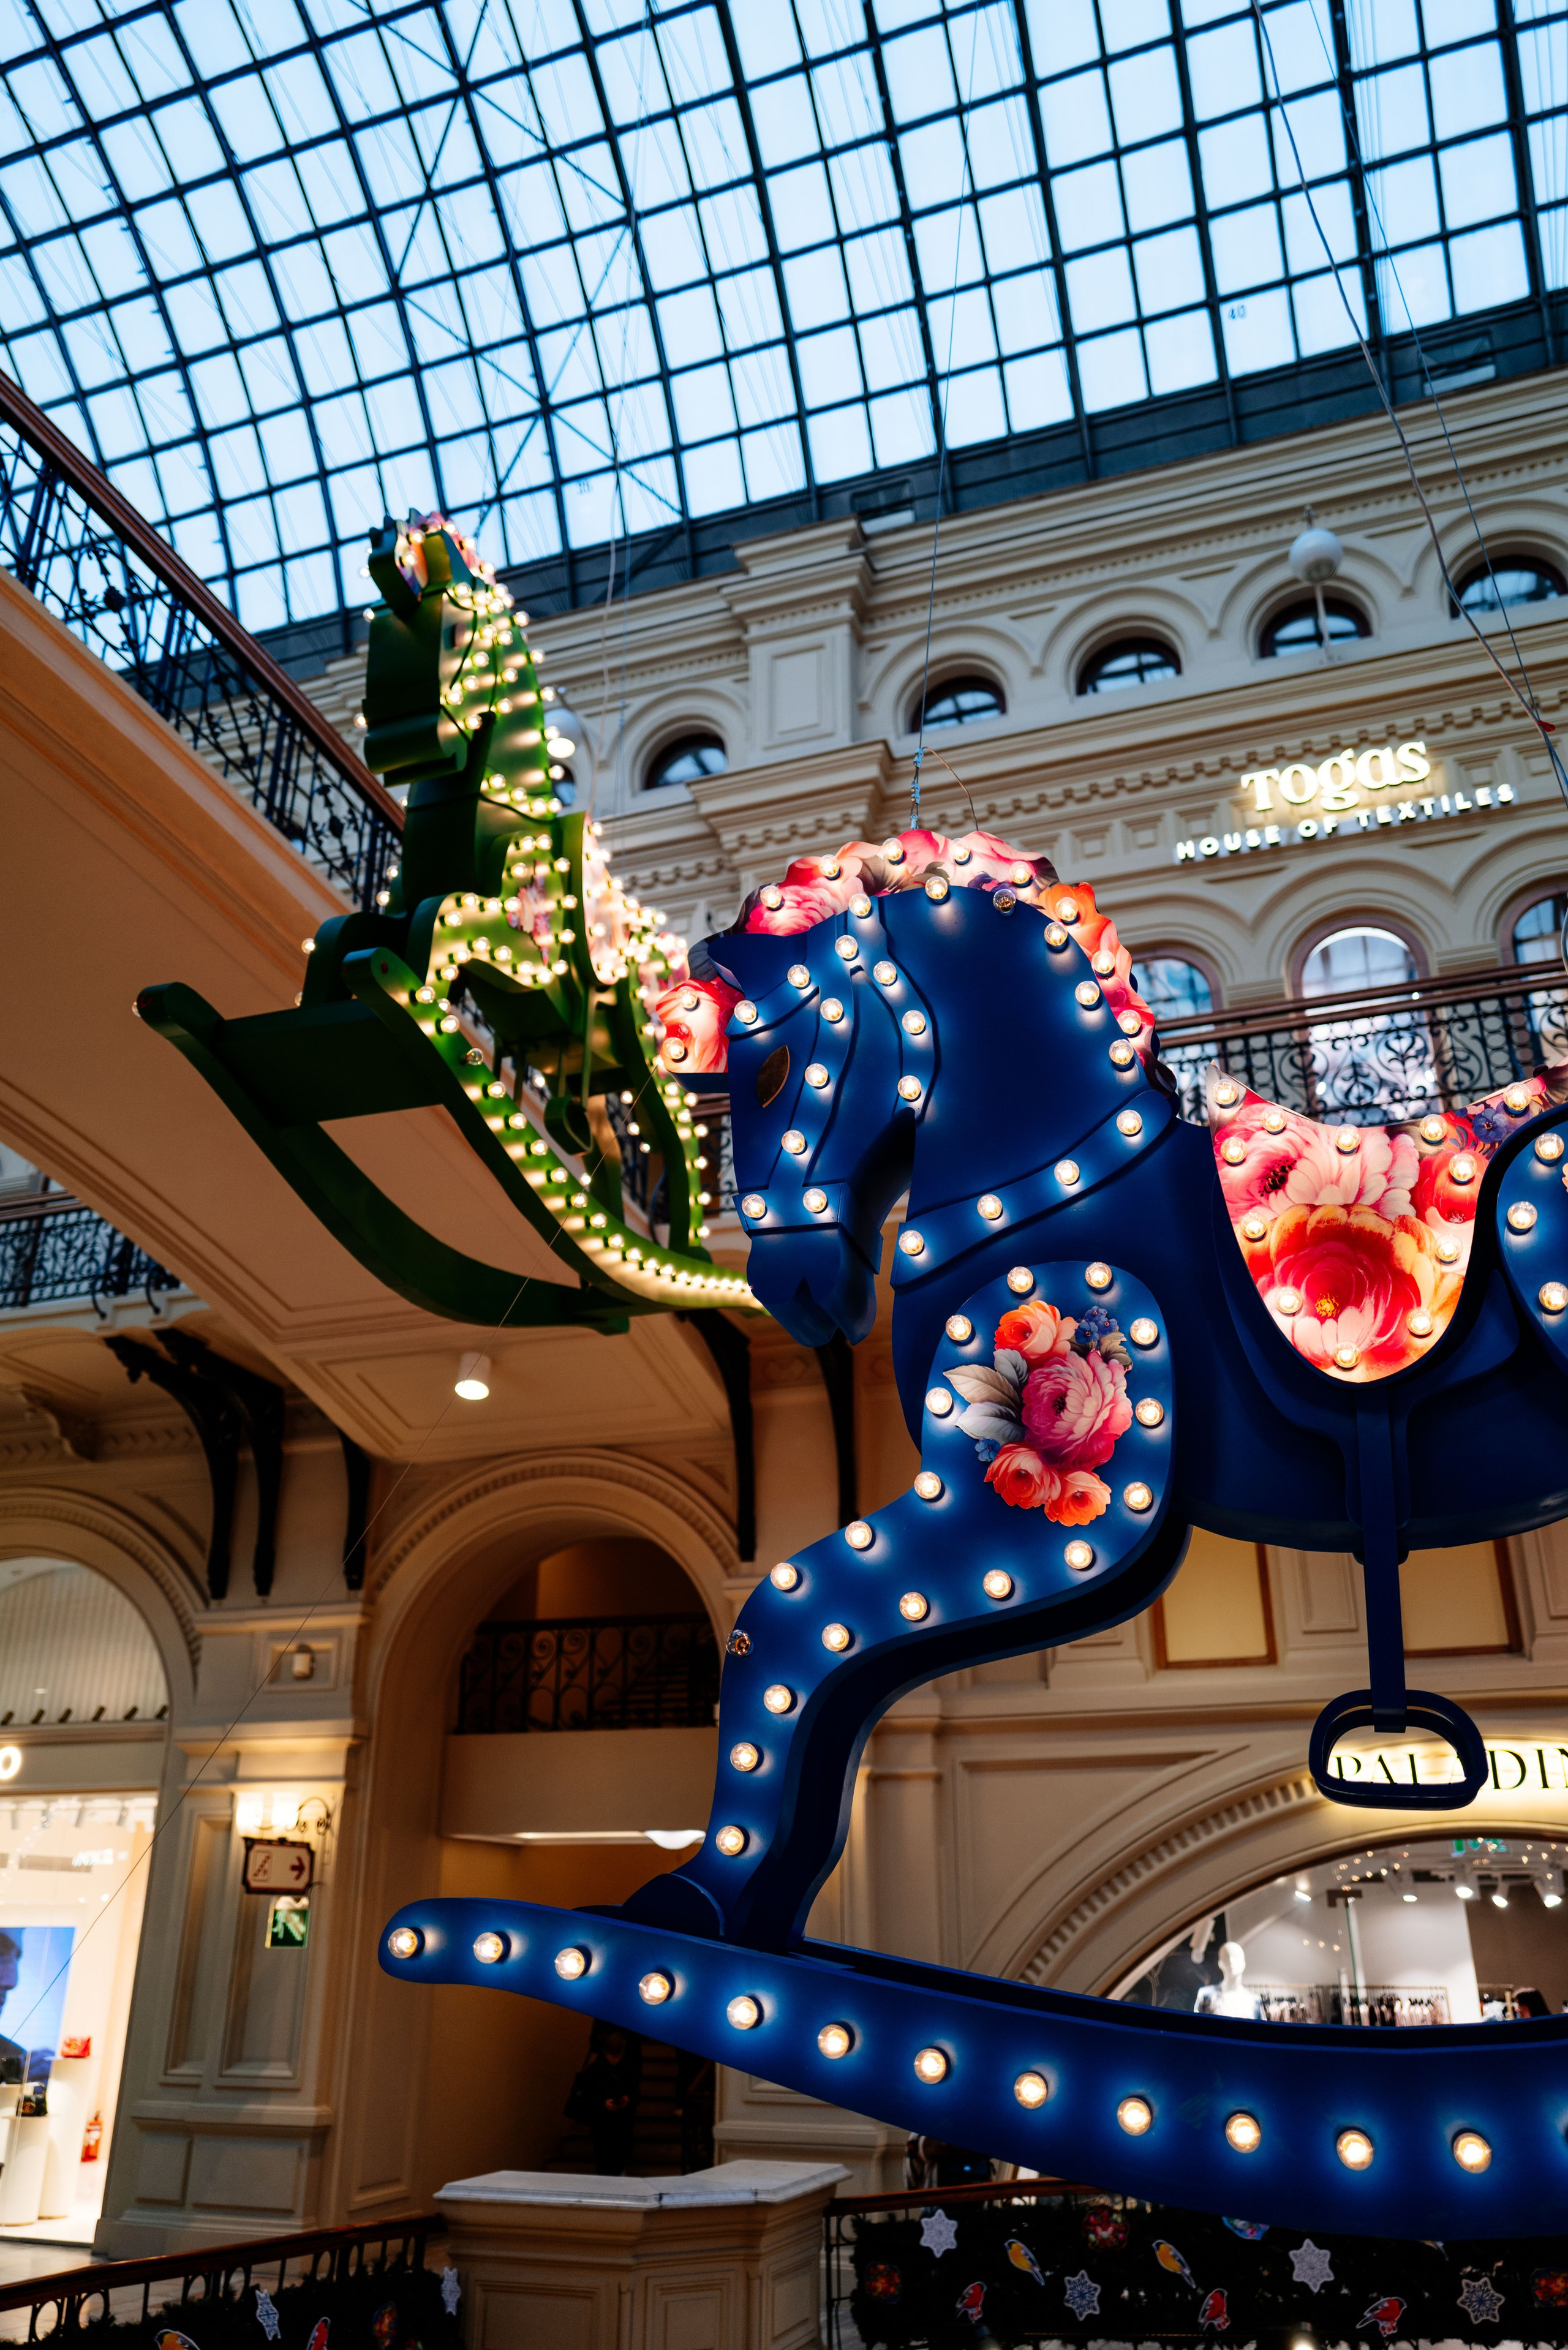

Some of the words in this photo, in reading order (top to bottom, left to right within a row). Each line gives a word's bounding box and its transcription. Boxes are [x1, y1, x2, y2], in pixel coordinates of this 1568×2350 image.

[1241, 740, 1431, 812] Togas
[1176, 824, 1281, 861] HOUSE
[1297, 815, 1339, 839] OF
[1355, 783, 1515, 829] TEXTILES
